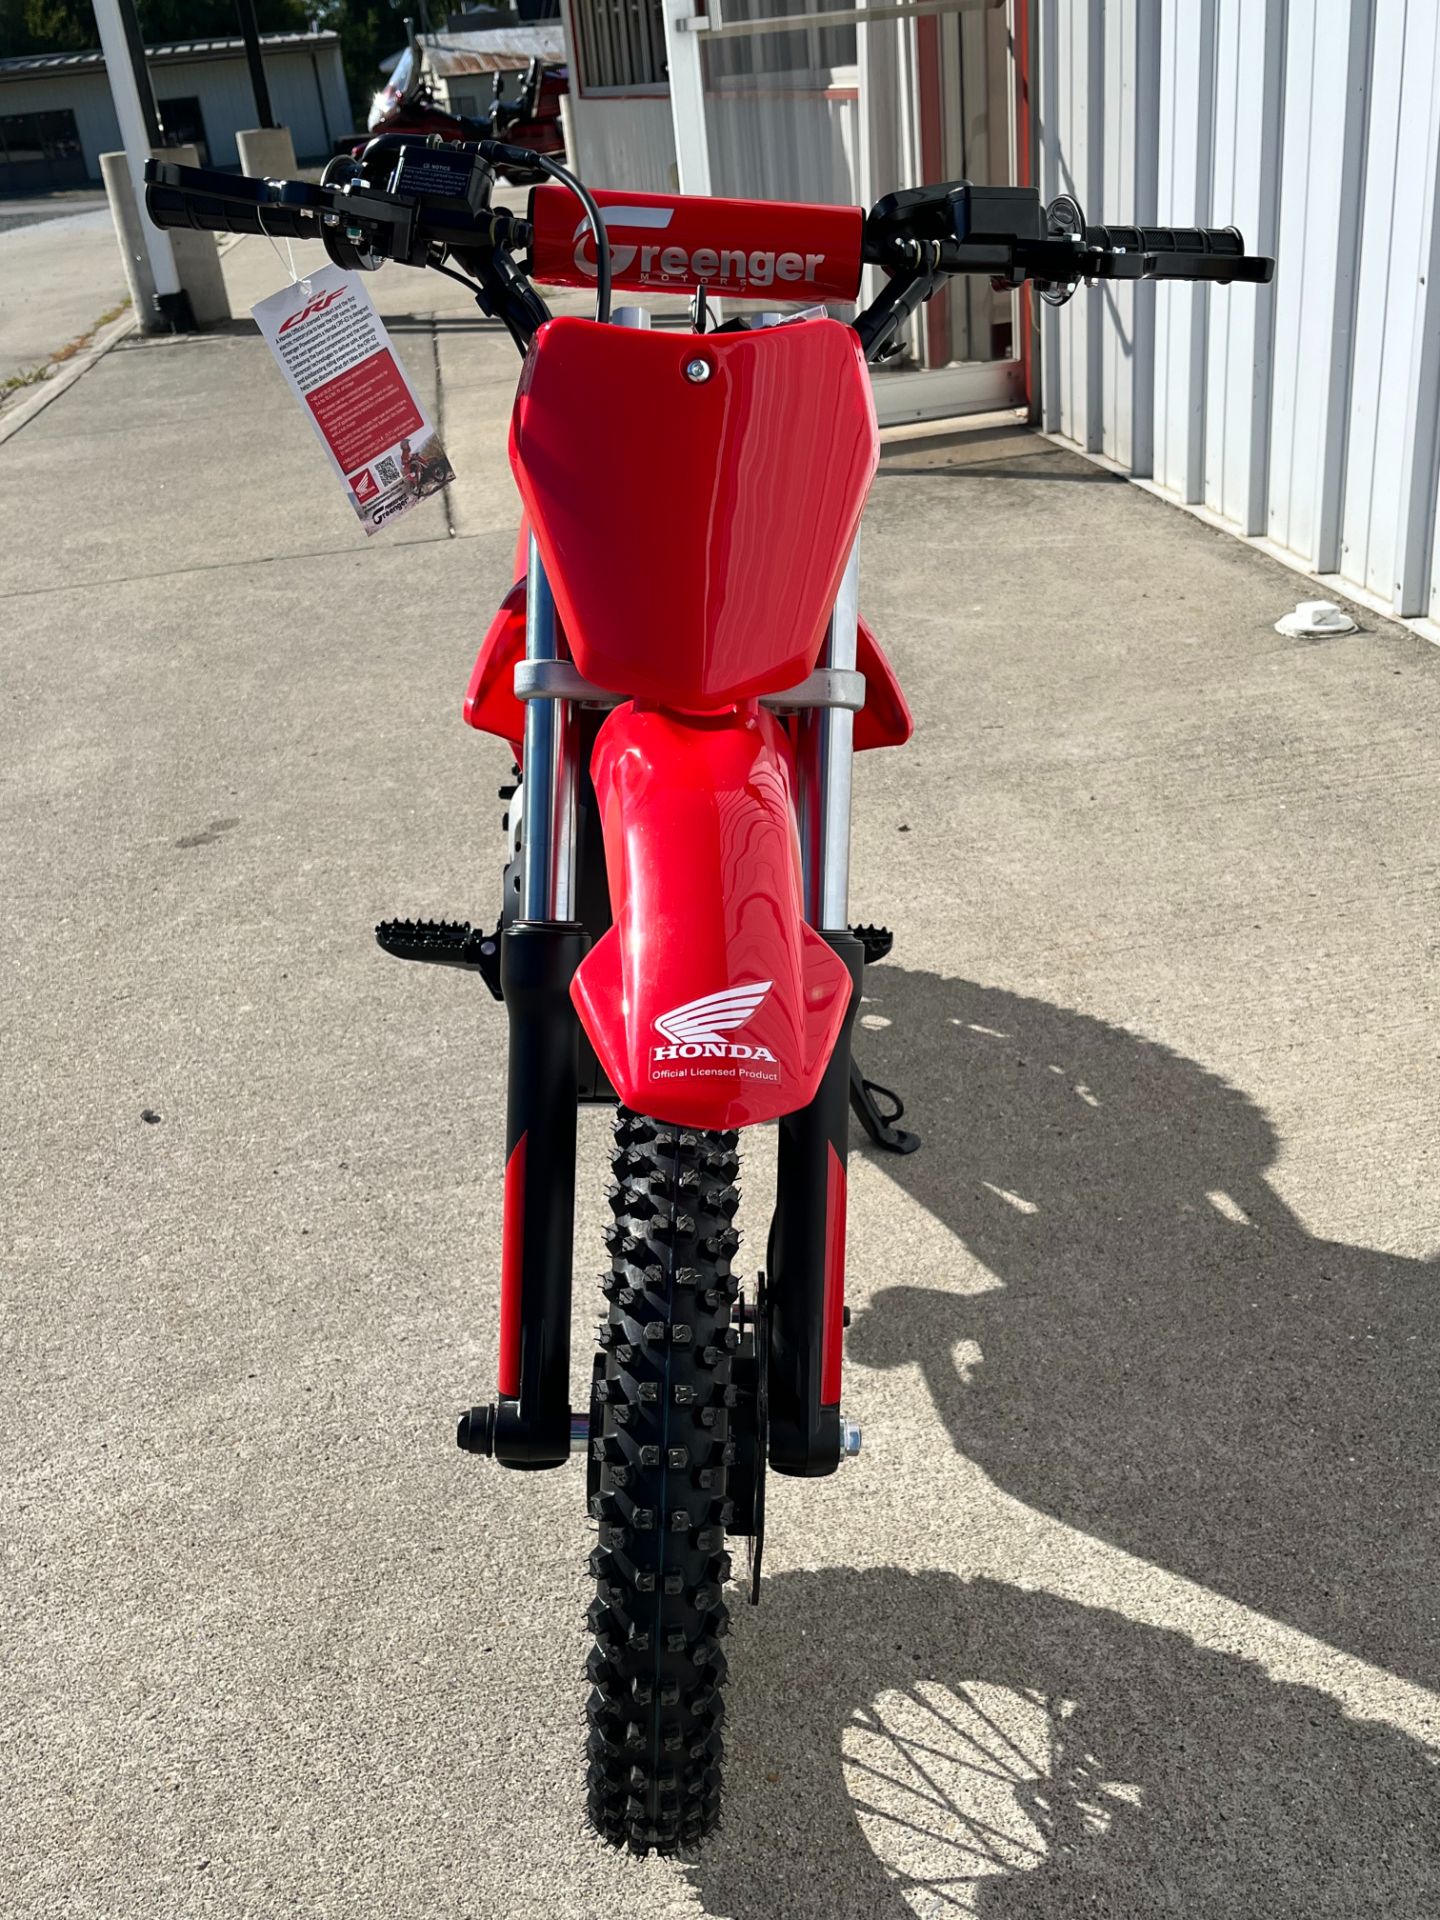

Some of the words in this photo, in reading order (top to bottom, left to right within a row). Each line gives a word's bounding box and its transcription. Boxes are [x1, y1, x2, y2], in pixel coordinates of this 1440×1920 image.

[572, 205, 825, 287] Greenger
[640, 273, 747, 287] MOTORS
[372, 496, 409, 524] Greenger
[653, 1043, 777, 1063] HONDA
[652, 1068, 687, 1080] Official
[690, 1068, 736, 1077] Licensed
[738, 1068, 778, 1081] Product
